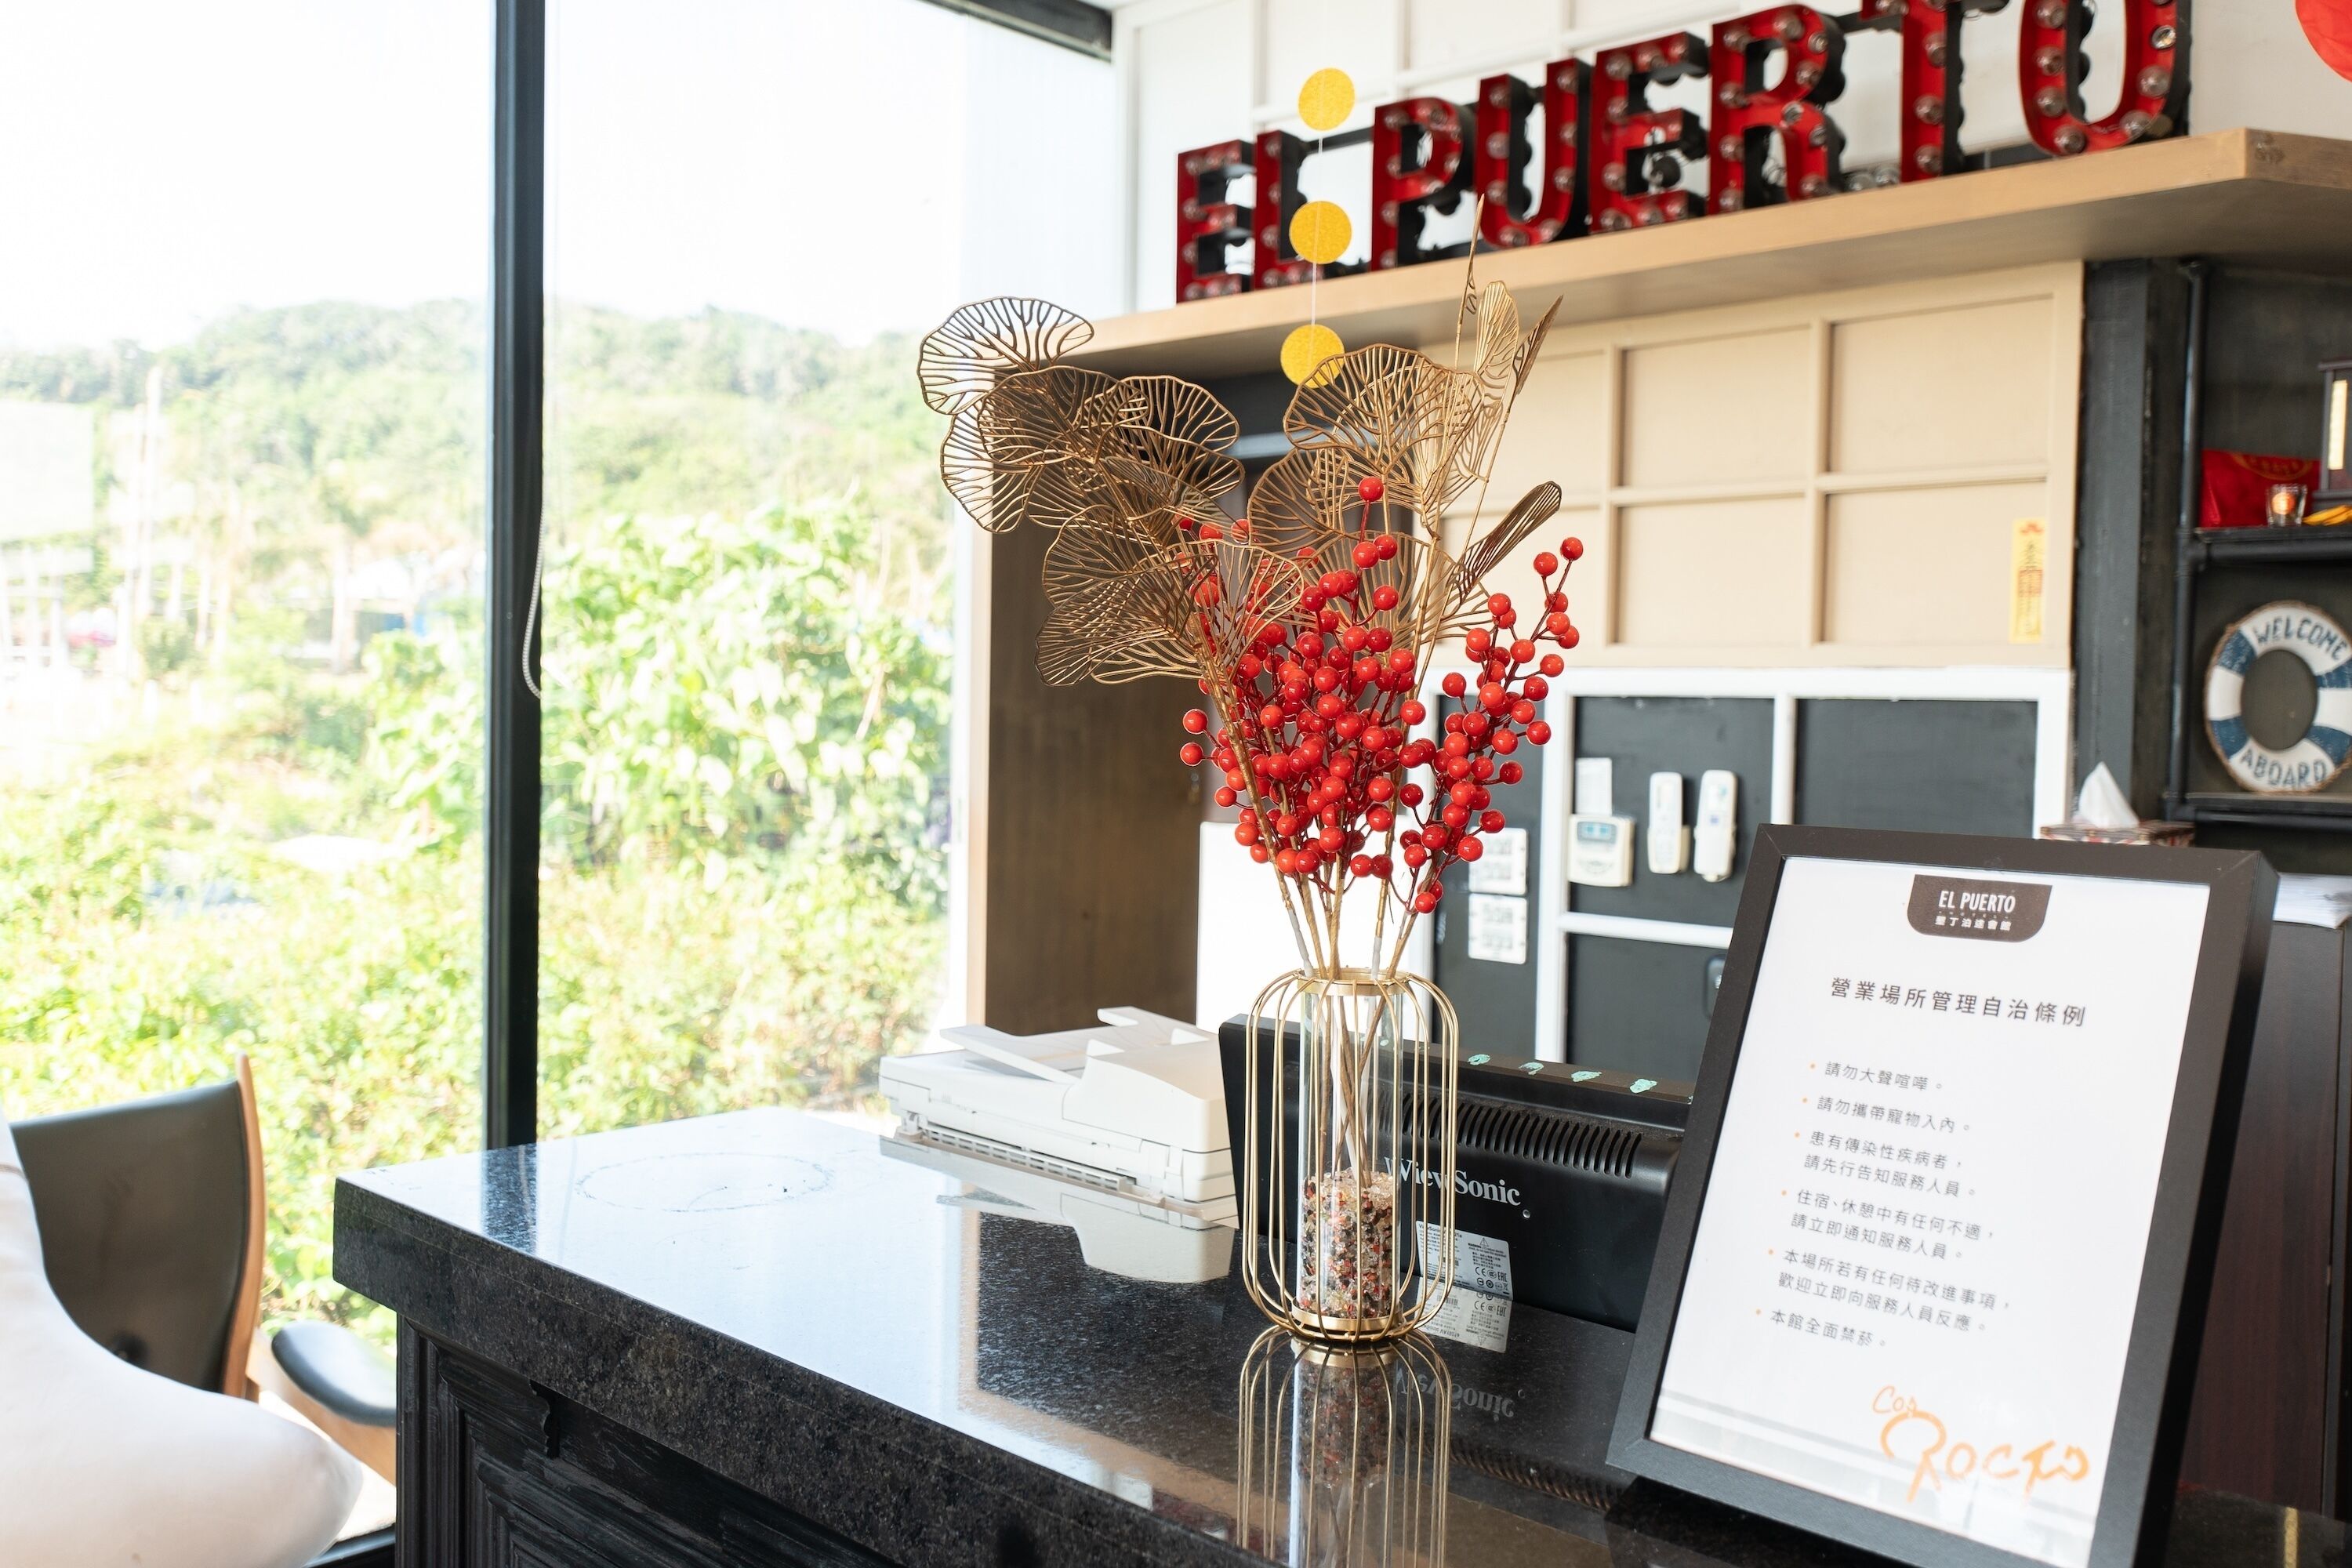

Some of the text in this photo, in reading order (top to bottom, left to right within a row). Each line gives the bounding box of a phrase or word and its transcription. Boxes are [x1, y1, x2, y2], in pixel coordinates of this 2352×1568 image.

[1176, 0, 2191, 303] EL PUERTO
[2252, 615, 2347, 661] WELCOME
[2240, 748, 2327, 790] ABOARD
[1938, 890, 2016, 913] EL PUERTO
[1831, 977, 2086, 1027] 營業場所管理自治條例
[1804, 1153, 1976, 1197] 請先行告知服務人員。
[1791, 1213, 1962, 1260] 請立即通知服務人員。
